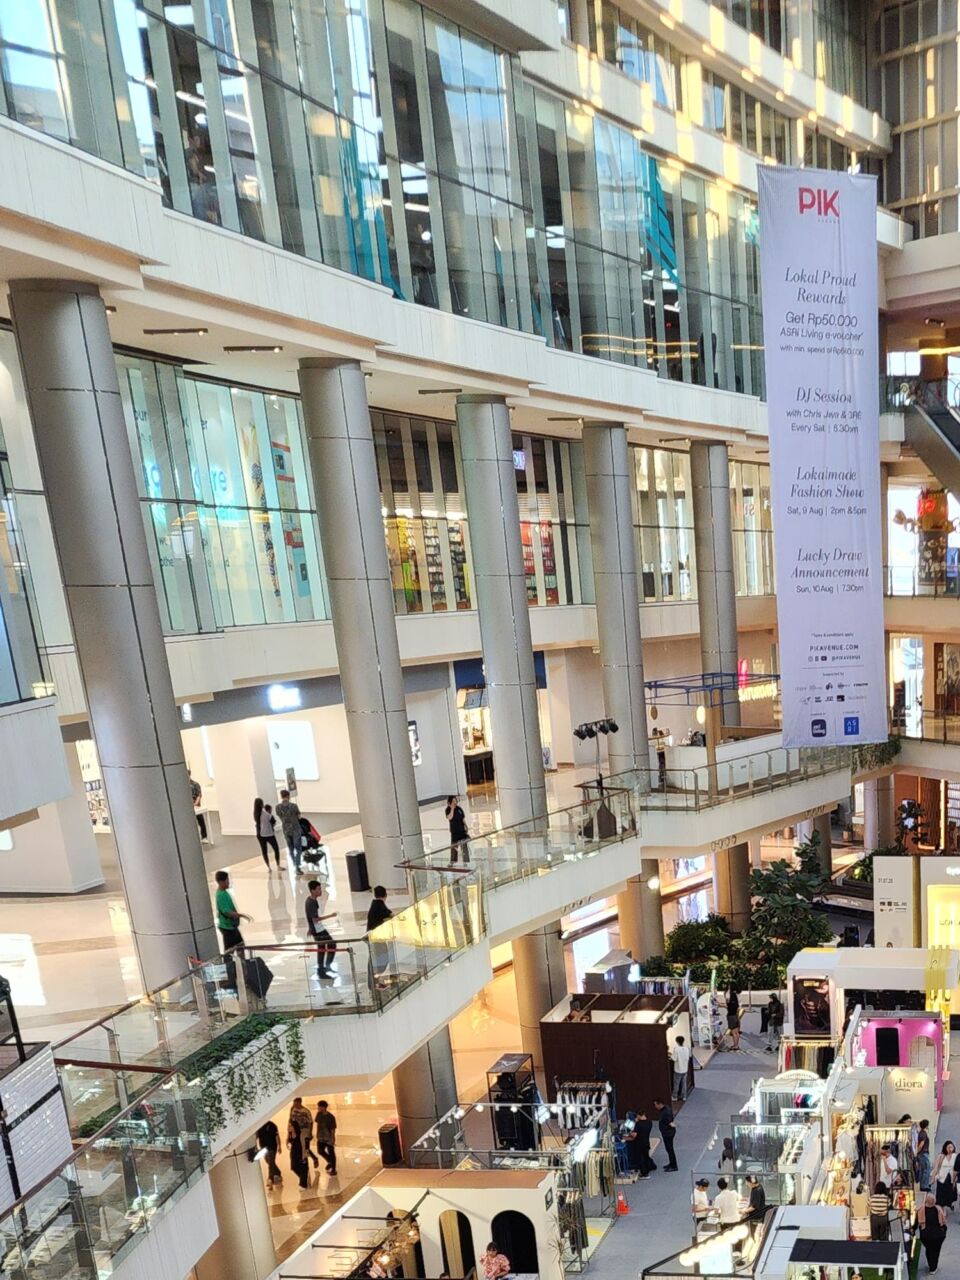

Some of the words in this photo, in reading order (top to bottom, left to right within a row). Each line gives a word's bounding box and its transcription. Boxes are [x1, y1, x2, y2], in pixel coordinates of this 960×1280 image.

[799, 187, 840, 218] PIK
[785, 267, 819, 284] Lokal
[822, 270, 857, 287] Proud
[797, 287, 847, 305] Rewards
[785, 311, 804, 324] Get
[801, 328, 824, 340] Living
[796, 387, 811, 403] DJ
[813, 387, 852, 404] Session
[786, 410, 801, 418] with
[791, 423, 812, 433] Every
[813, 423, 825, 432] Sat
[797, 466, 857, 481] Lokalmade
[790, 484, 832, 498] Fashion
[835, 484, 865, 498] Show
[802, 506, 808, 515] 9
[809, 506, 824, 517] Aug
[830, 506, 845, 516] 2pm
[797, 547, 831, 566] Lucky
[833, 547, 863, 561] Draw
[790, 565, 869, 579] Announcement
[812, 584, 821, 593] 10
[821, 584, 834, 594] Aug
[895, 1078, 923, 1088] diora
